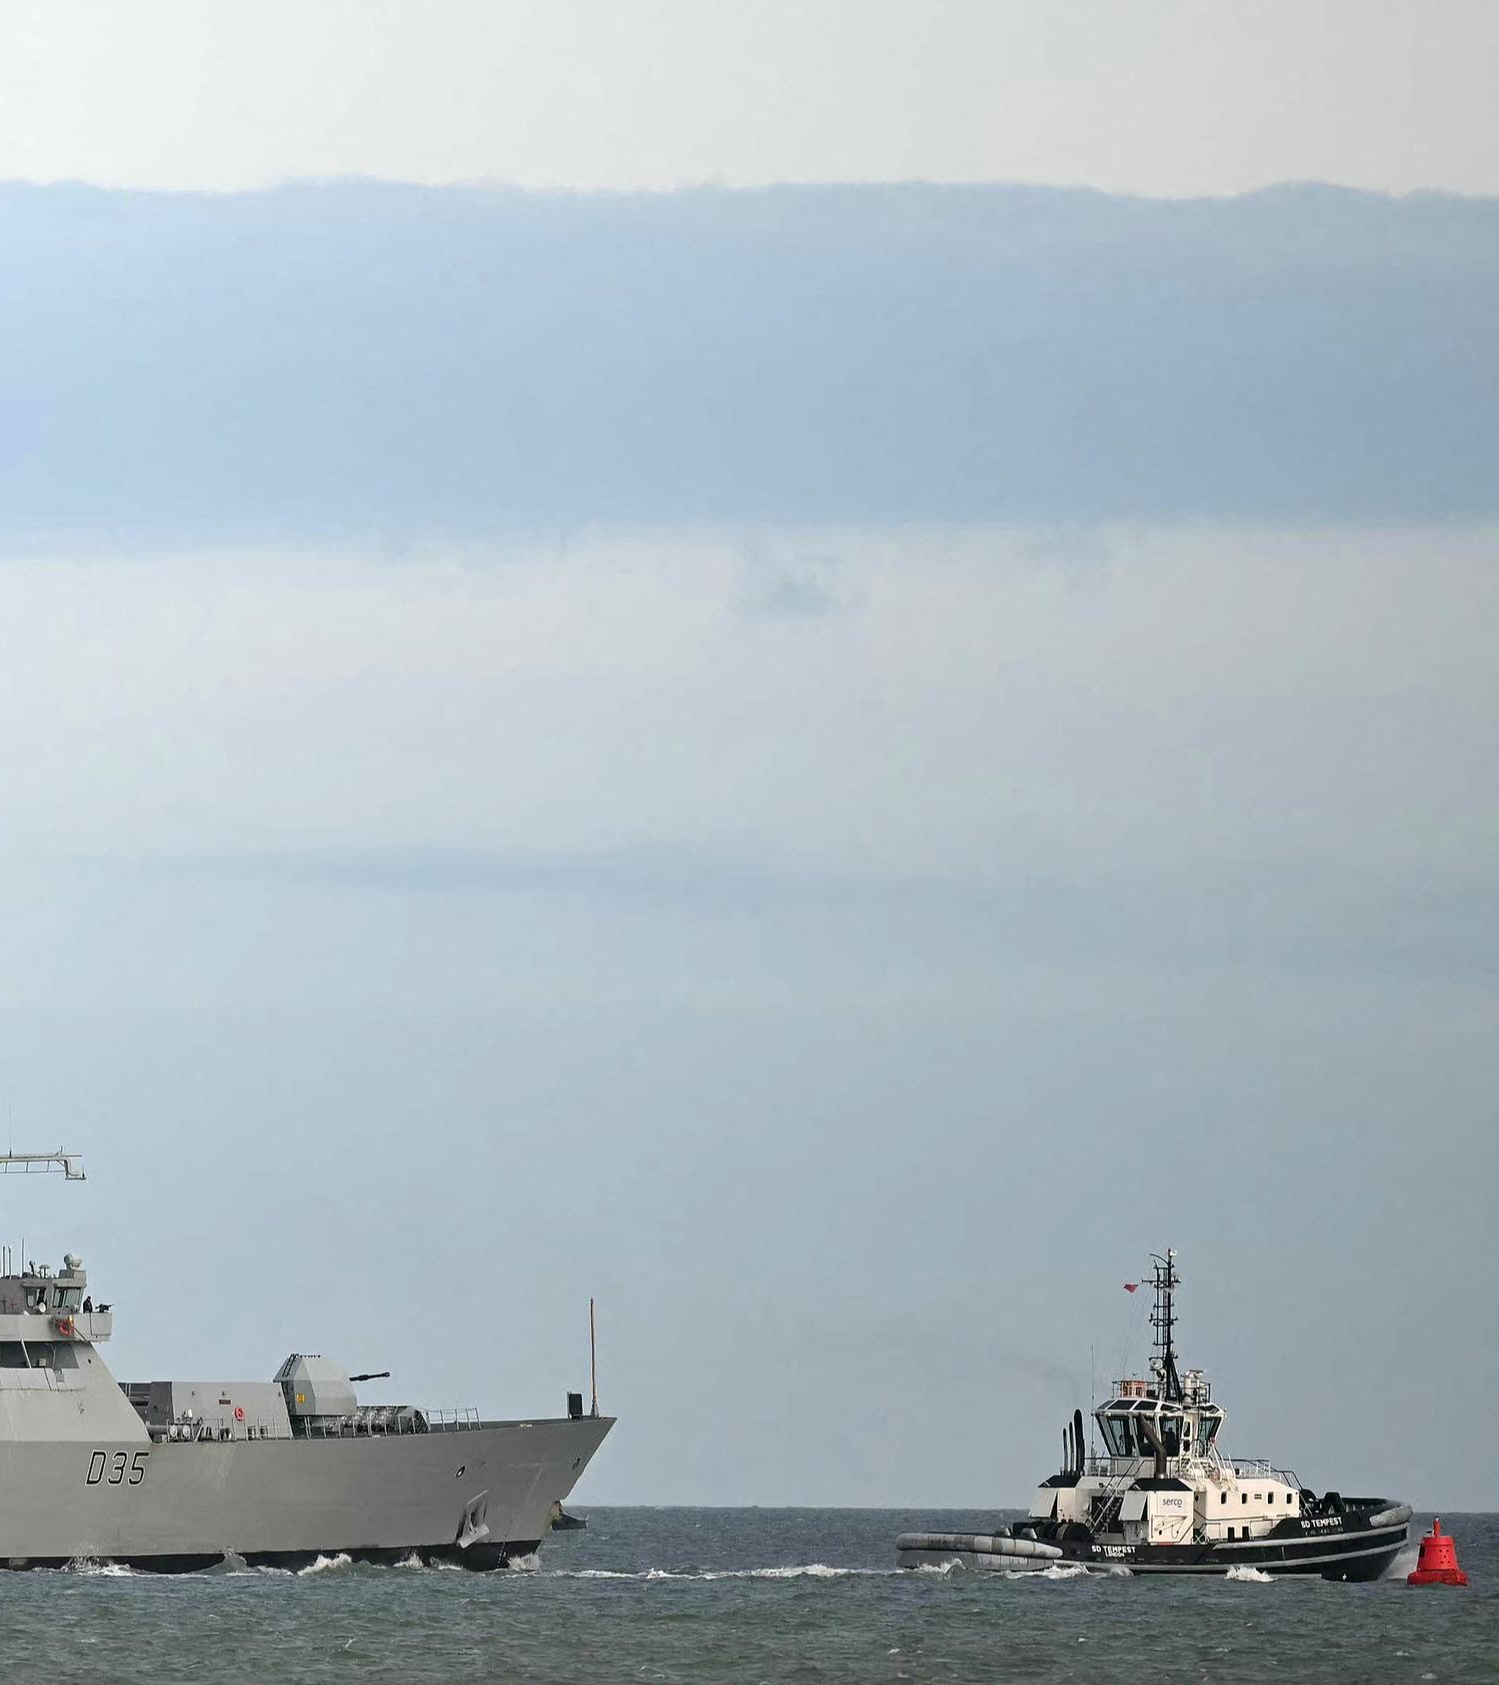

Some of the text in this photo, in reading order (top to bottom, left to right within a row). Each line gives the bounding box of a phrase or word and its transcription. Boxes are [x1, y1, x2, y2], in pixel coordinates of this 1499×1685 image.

[85, 1449, 150, 1487] D35
[1162, 1498, 1183, 1508] serco
[1301, 1516, 1342, 1529] SD TEMPEST
[1091, 1545, 1136, 1554] SD TEMPEST
